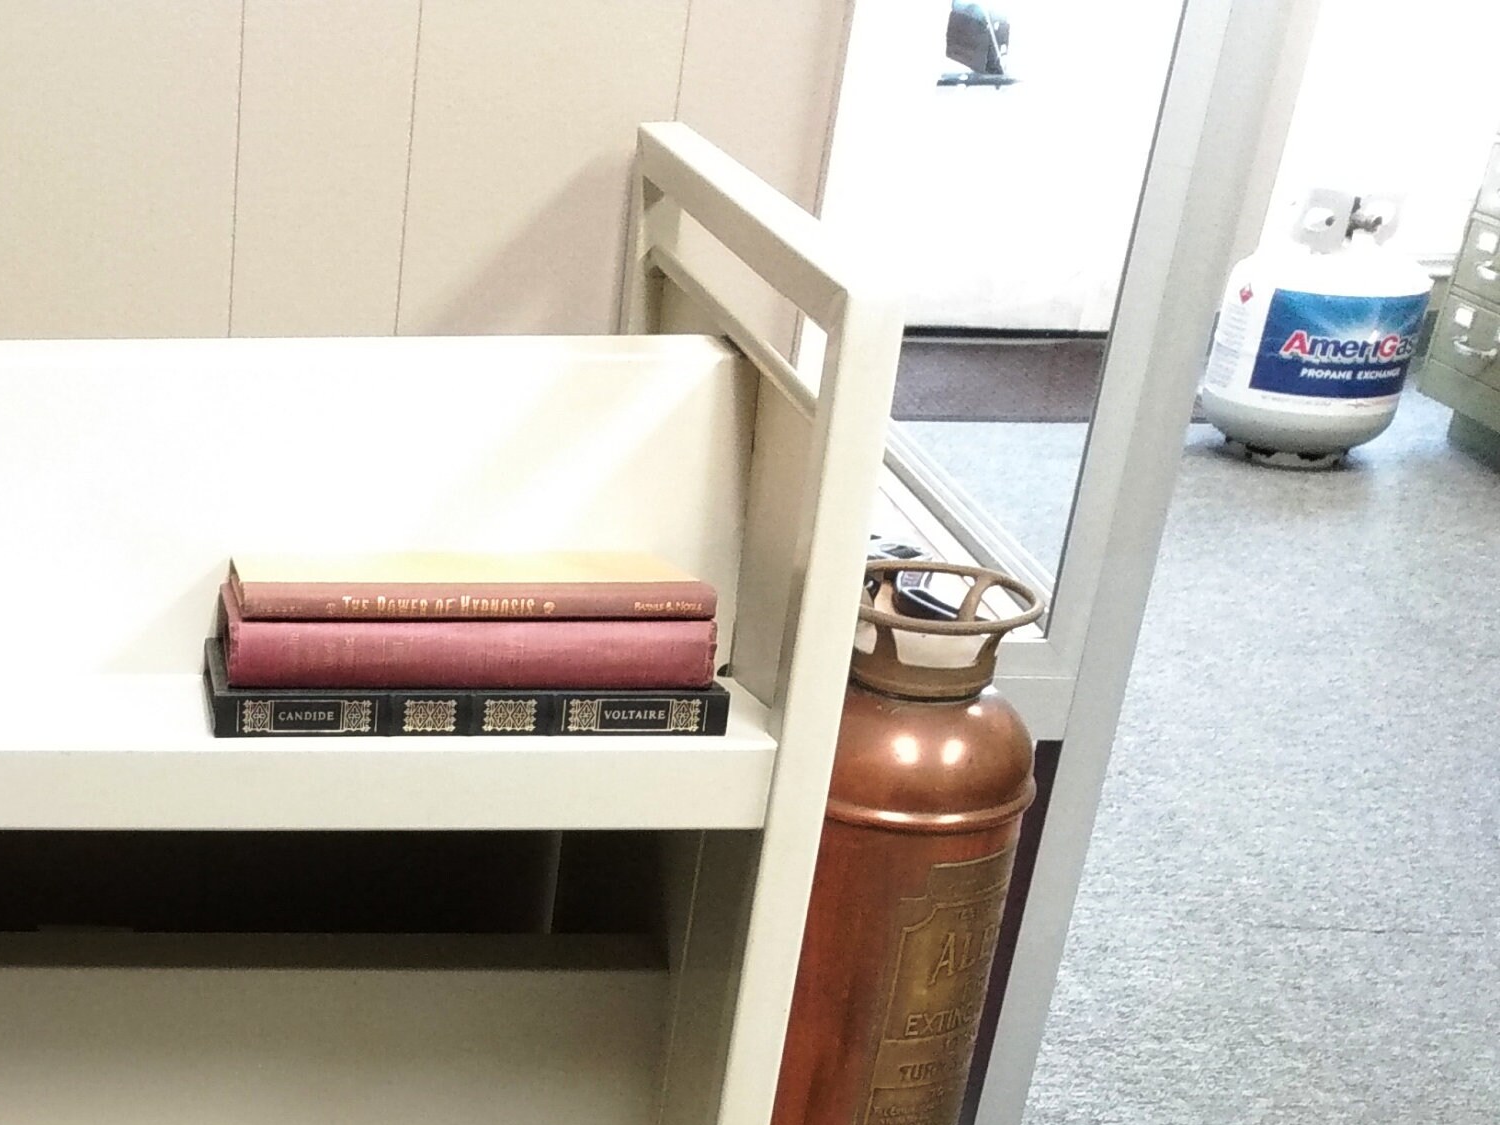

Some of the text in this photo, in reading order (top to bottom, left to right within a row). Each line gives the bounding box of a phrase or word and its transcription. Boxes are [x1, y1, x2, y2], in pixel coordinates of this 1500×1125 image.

[1300, 367, 1353, 380] PROPANE
[278, 711, 334, 721] CANDIDE
[604, 709, 666, 720] VOLTAIRE
